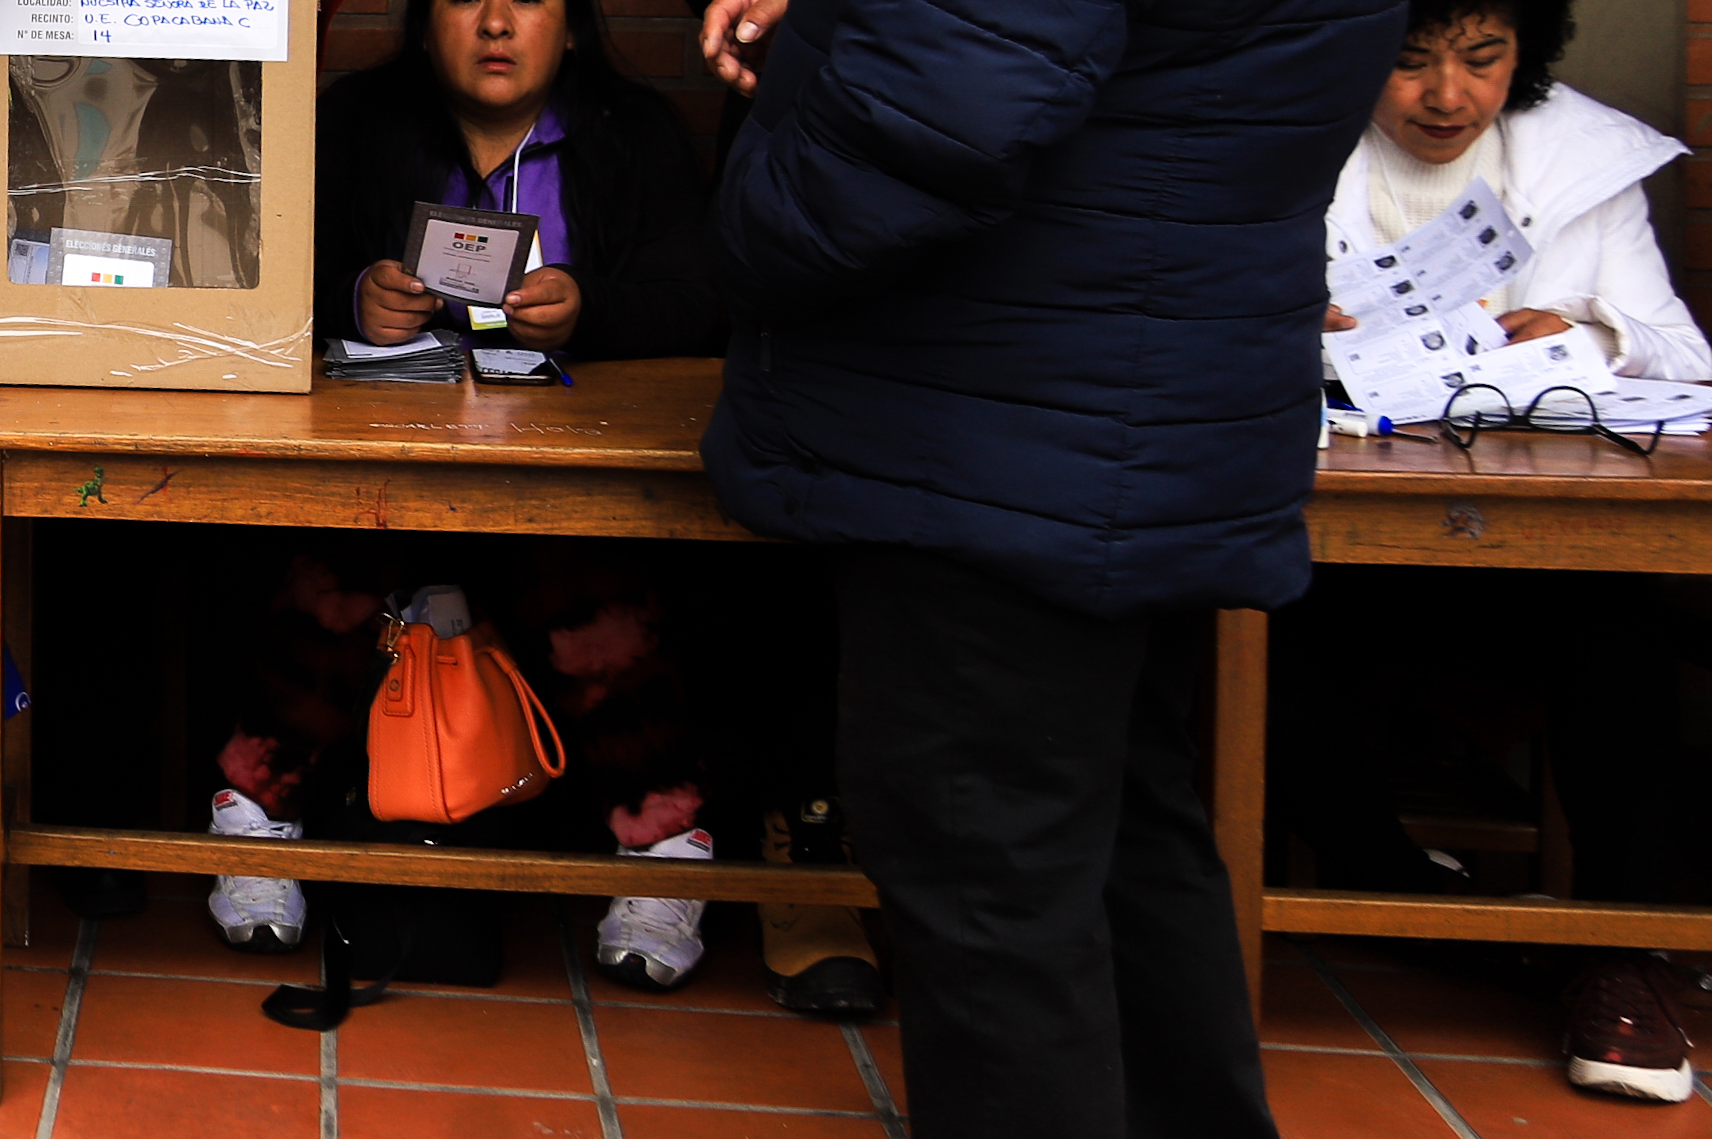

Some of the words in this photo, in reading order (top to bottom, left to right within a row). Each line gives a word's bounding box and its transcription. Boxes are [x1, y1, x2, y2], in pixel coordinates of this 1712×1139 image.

[243, 0, 275, 12] PAZ
[31, 13, 75, 24] RECINTO:
[124, 13, 234, 28] COPACABANA
[238, 16, 251, 29] C
[30, 30, 43, 40] DE
[45, 30, 75, 41] MESA:
[92, 29, 112, 43] 14
[65, 239, 112, 254] ELECCIONES
[112, 242, 156, 257] GENERALES
[452, 241, 487, 252] OEP
